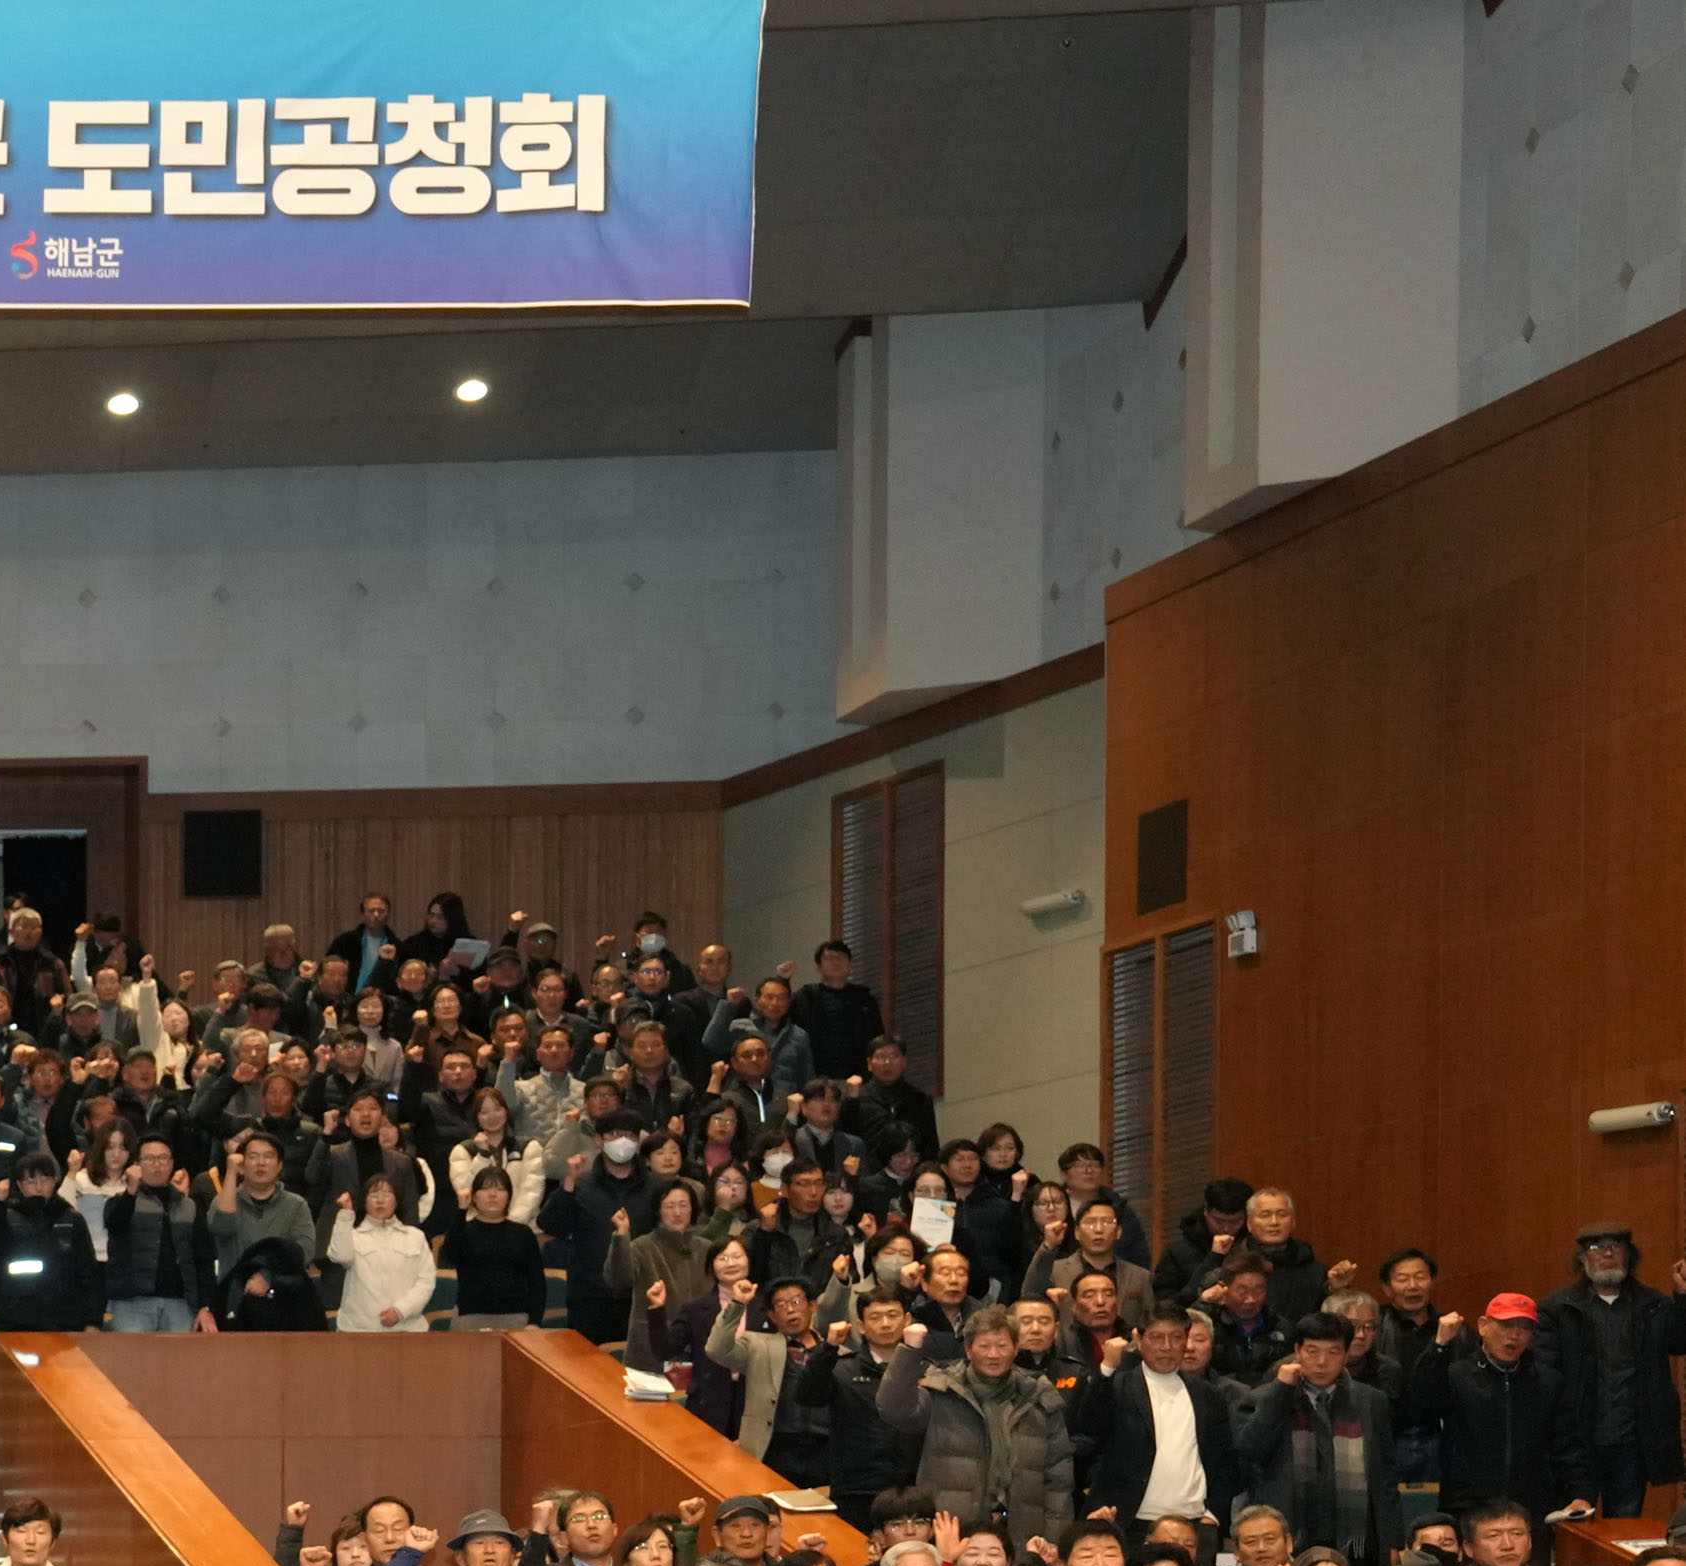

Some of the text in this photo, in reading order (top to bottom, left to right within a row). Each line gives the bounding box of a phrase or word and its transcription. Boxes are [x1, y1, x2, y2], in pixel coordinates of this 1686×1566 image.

[42, 93, 606, 216] 도민공청회
[44, 237, 124, 267] 해남군
[47, 268, 120, 279] HAENAM-GUN
